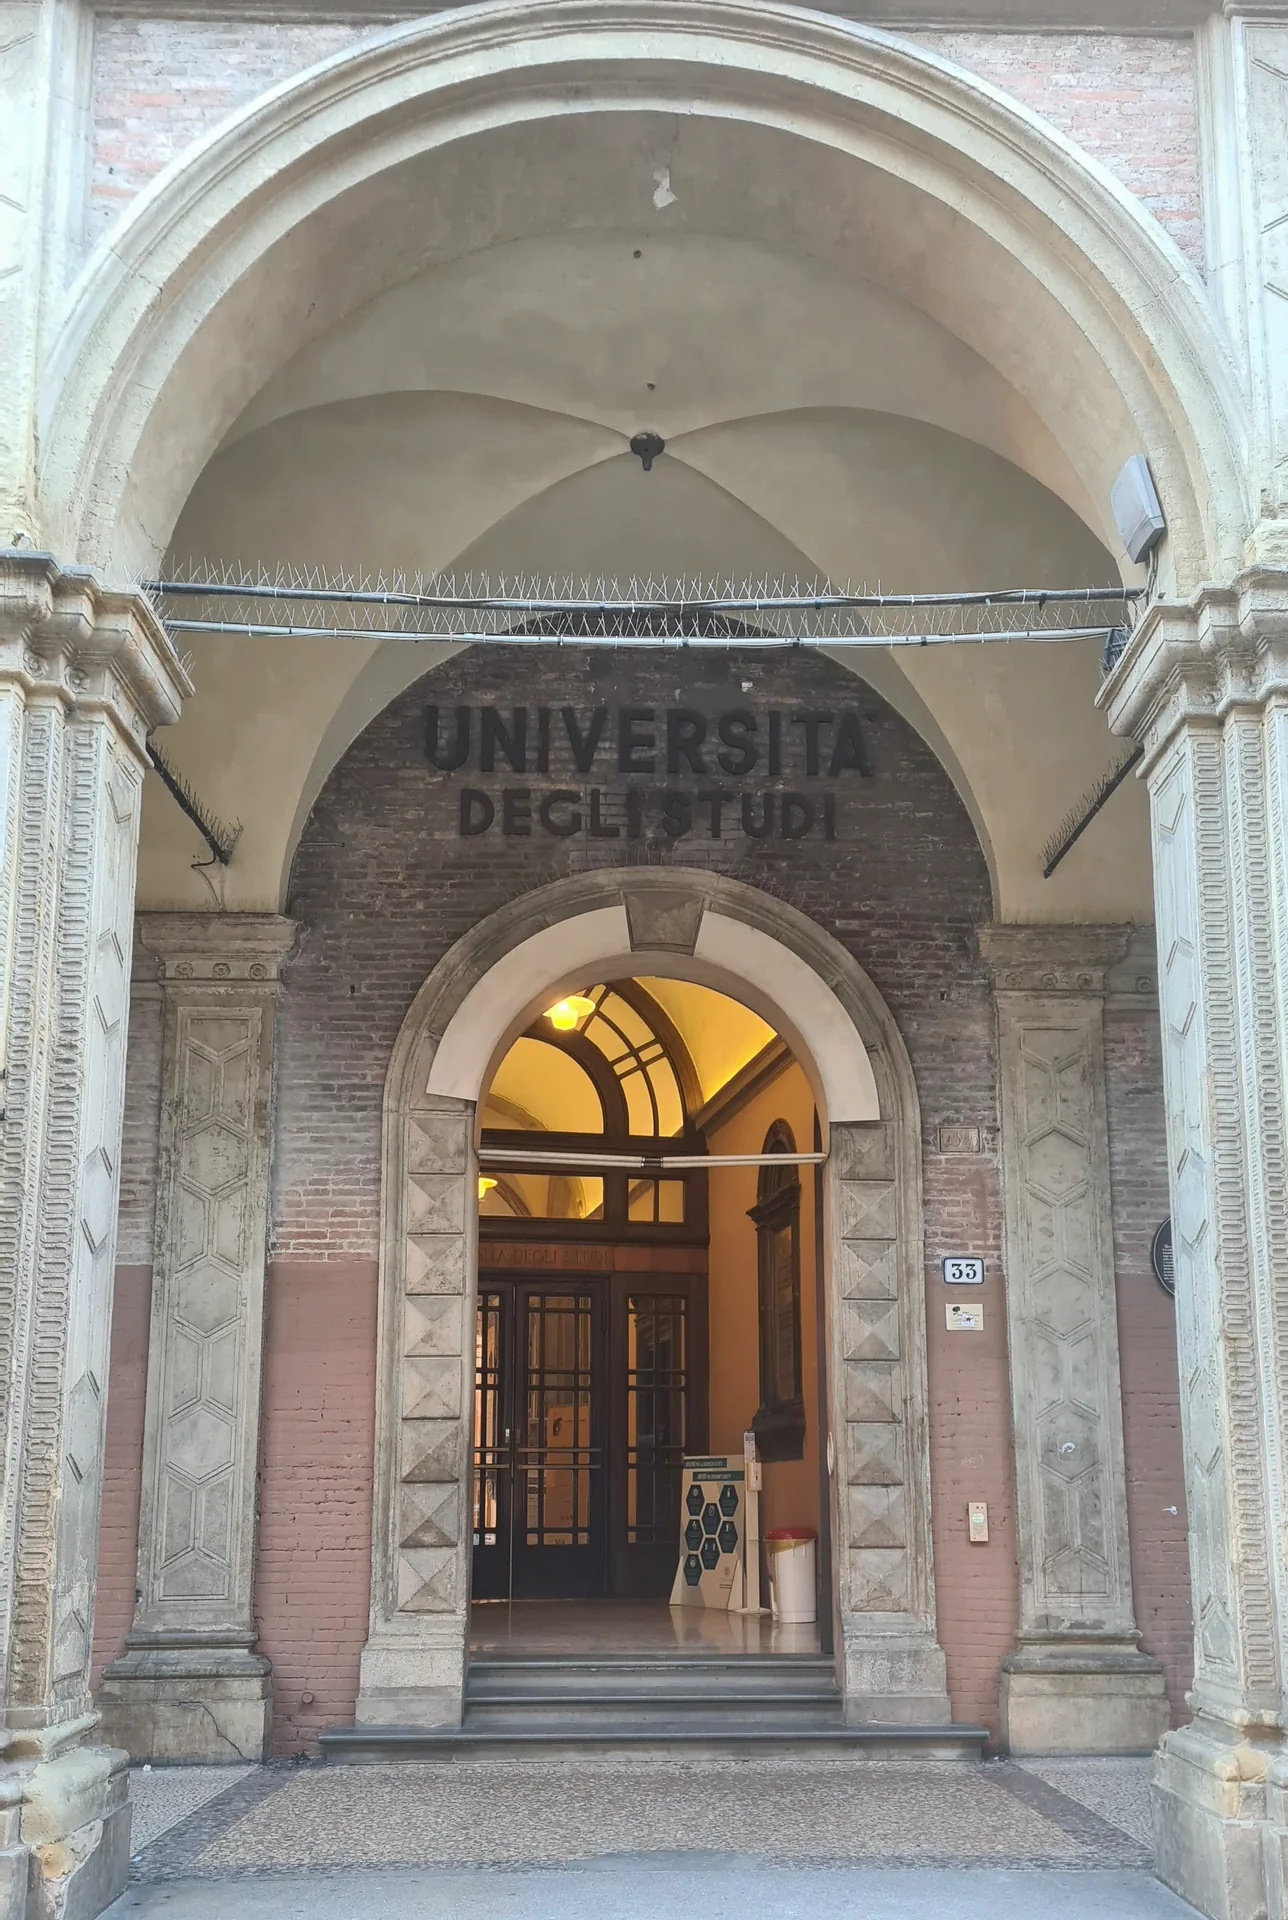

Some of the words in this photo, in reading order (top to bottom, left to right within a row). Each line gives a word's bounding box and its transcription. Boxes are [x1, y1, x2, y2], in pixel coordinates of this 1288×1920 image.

[460, 788, 641, 837] DEGLI
[662, 790, 836, 840] STUDI
[513, 1248, 557, 1265] DEGLI
[951, 1263, 977, 1280] 33
